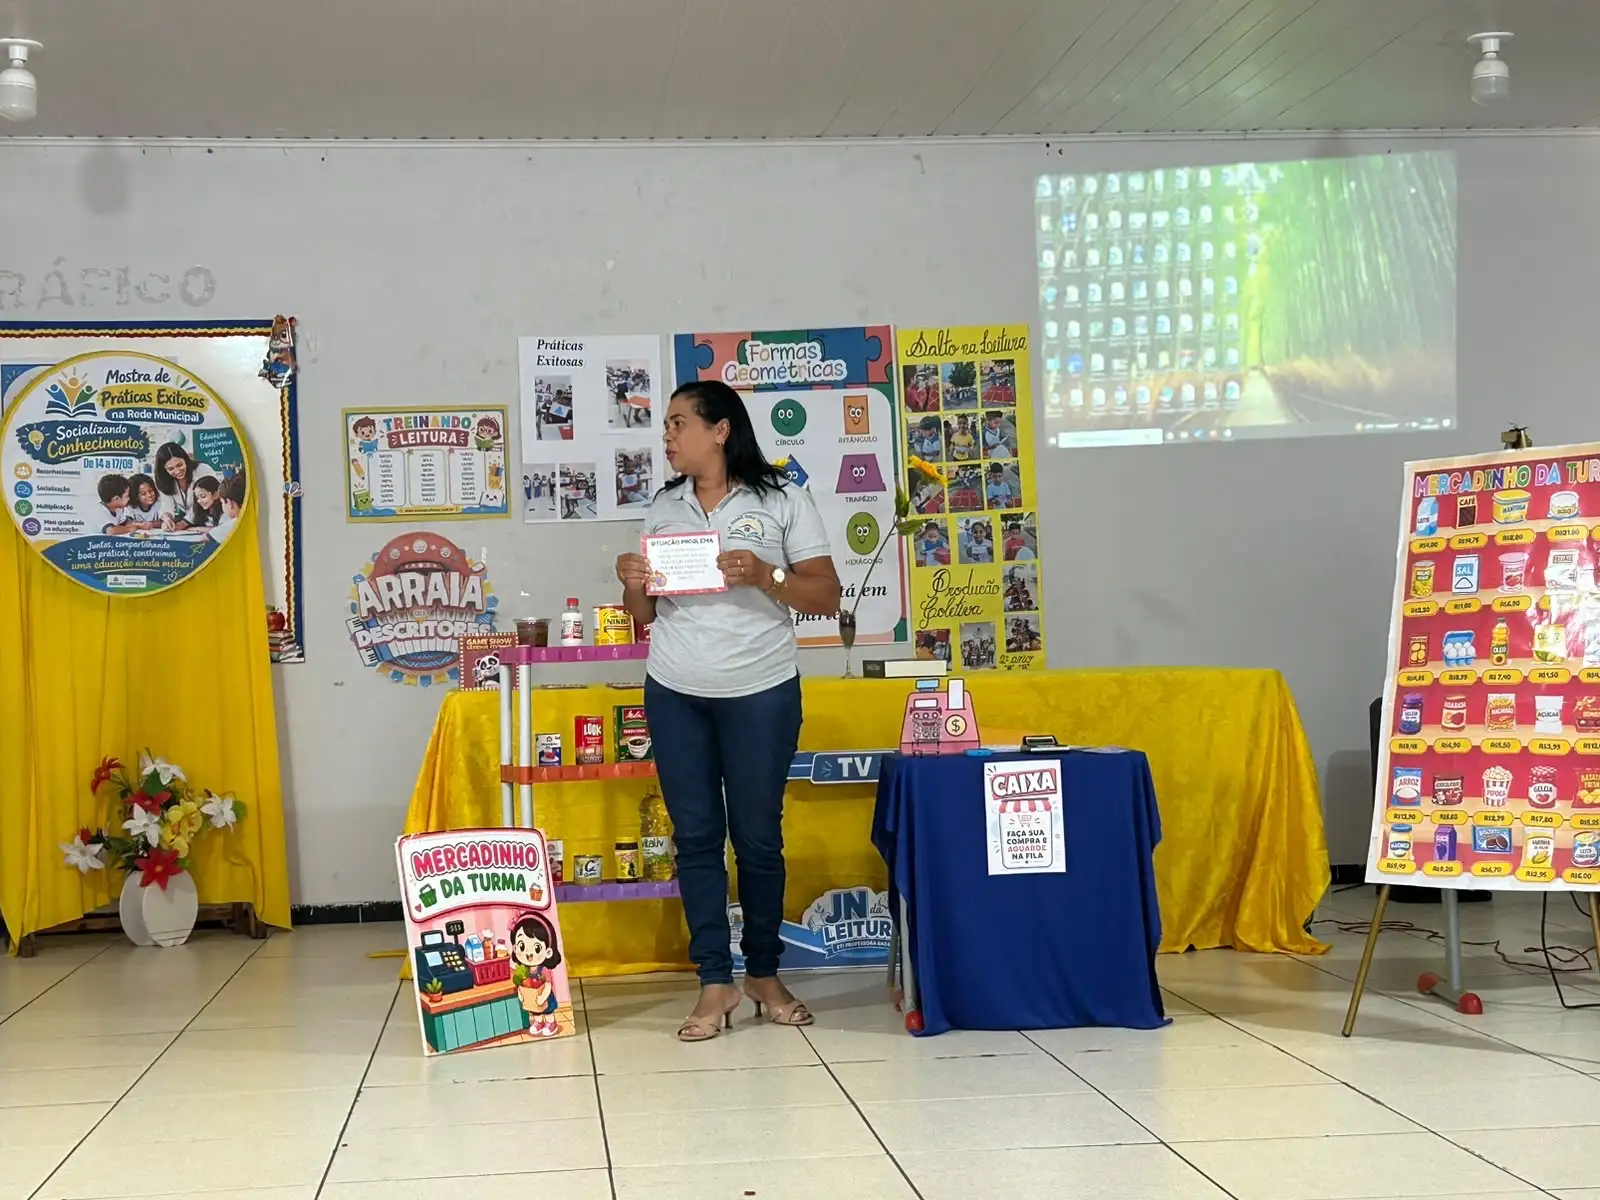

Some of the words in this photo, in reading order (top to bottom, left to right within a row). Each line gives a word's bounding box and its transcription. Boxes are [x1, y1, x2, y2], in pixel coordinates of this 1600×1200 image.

[537, 339, 584, 351] Práticas
[906, 328, 959, 358] Salto
[961, 342, 979, 355] na
[980, 327, 1028, 355] Leitura
[748, 343, 818, 361] Formas
[537, 355, 584, 367] Exitosas
[106, 369, 152, 384] Mostra
[154, 368, 171, 383] de
[725, 360, 844, 381] Geométricas
[100, 389, 152, 407] Práticas
[157, 389, 205, 408] Exitosas
[111, 411, 124, 419] na
[127, 409, 152, 419] Rede
[154, 410, 199, 422] Municipal
[383, 415, 472, 431] TREINANDO
[56, 423, 127, 441] Socializando
[399, 431, 458, 445] LEITURA
[47, 436, 145, 459] Conhecimentos
[775, 438, 805, 446] CÍRCULO
[83, 458, 94, 468] De
[95, 458, 104, 469] 14
[1415, 465, 1531, 498] MERCADINHO
[1535, 462, 1561, 486] DA
[1566, 459, 1600, 484] TUR
[845, 495, 878, 503] TRAPÉZIO
[1459, 497, 1475, 506] CAFÉ
[77, 550, 97, 559] boas
[94, 560, 134, 570] educação
[135, 559, 161, 568] ainda
[1456, 566, 1473, 575] SAL
[861, 585, 888, 597] em
[919, 596, 983, 630] Coletiva
[489, 637, 512, 645] SHOW
[583, 723, 602, 736] LOOK
[837, 756, 873, 778] TV
[993, 770, 1056, 797] CAIXA
[1006, 830, 1027, 838] FAÇA
[1006, 837, 1041, 845] COMPRA
[1007, 844, 1047, 852] AGUARDE
[412, 842, 538, 879] MERCADINHO
[439, 876, 465, 899] DA
[467, 872, 527, 893] TURMA
[825, 889, 868, 923] JN
[870, 903, 884, 914] da
[824, 920, 892, 944] LEITUR
